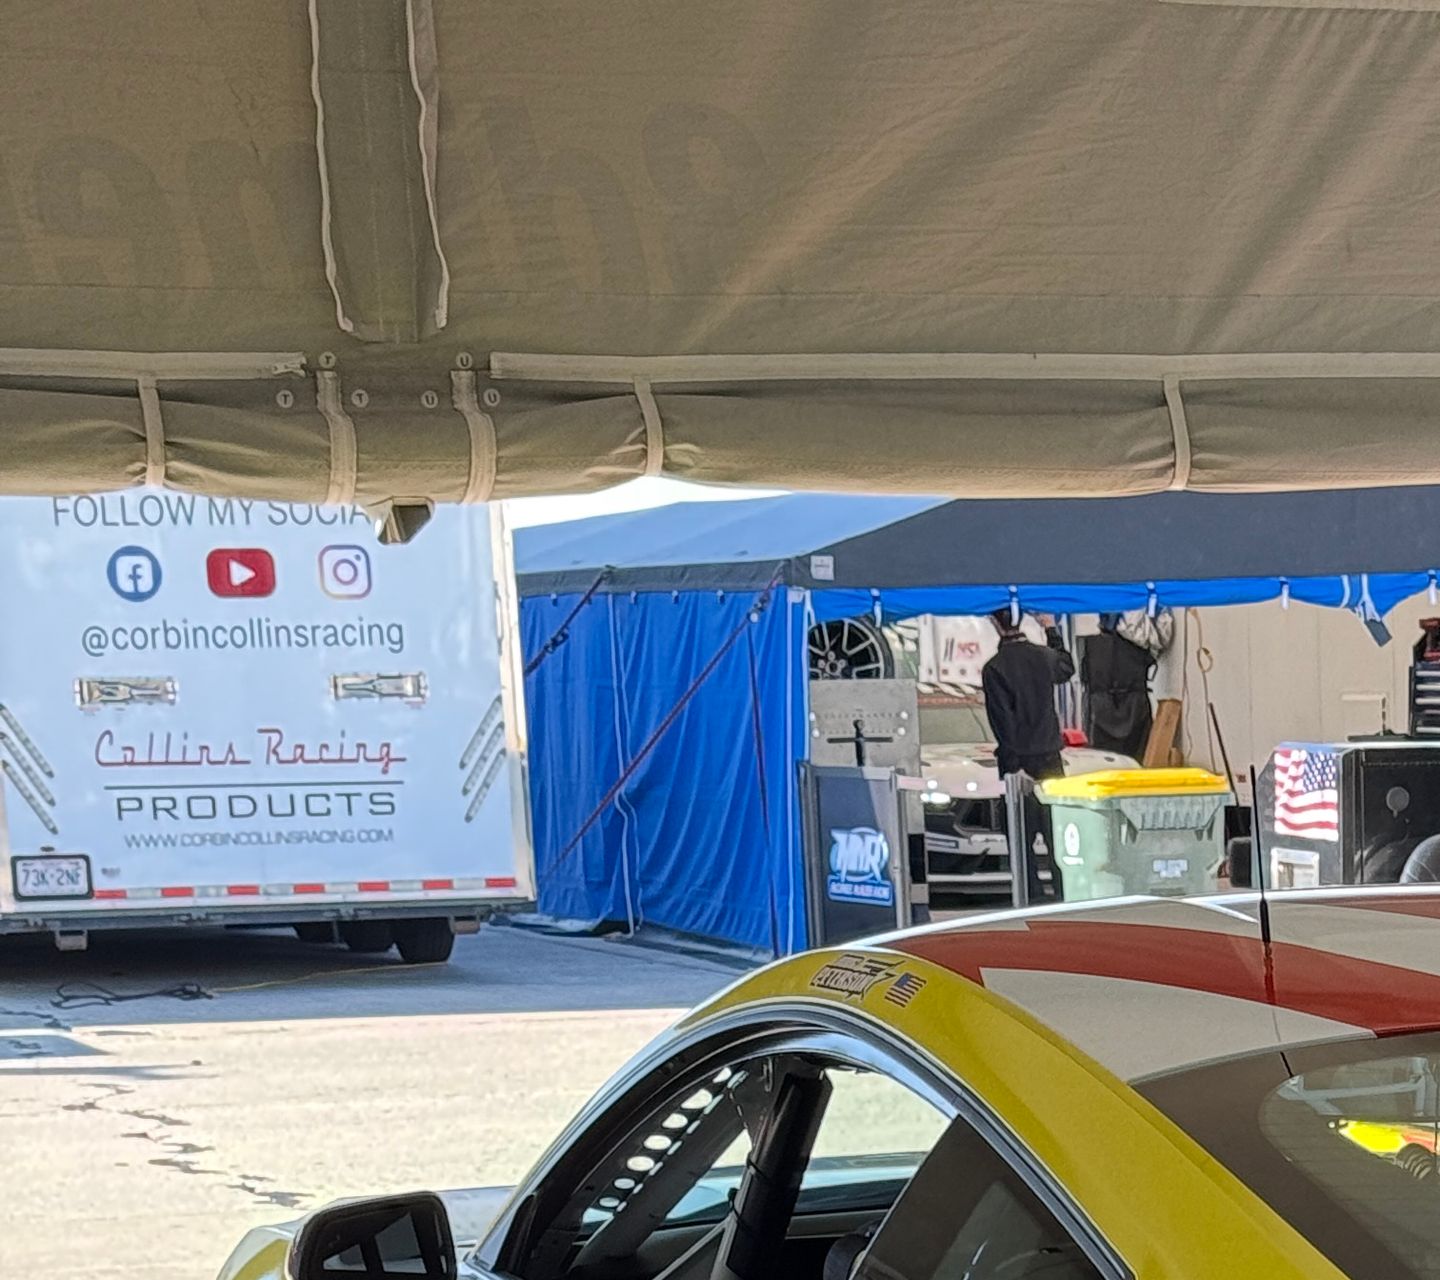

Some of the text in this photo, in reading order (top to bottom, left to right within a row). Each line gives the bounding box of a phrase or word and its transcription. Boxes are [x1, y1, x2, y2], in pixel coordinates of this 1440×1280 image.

[53, 496, 195, 527] FOLLOW
[208, 498, 254, 527] MY
[81, 616, 405, 657] @corbincollinsracing
[94, 727, 408, 776] Collins Racing
[115, 792, 396, 821] PRODUCTS
